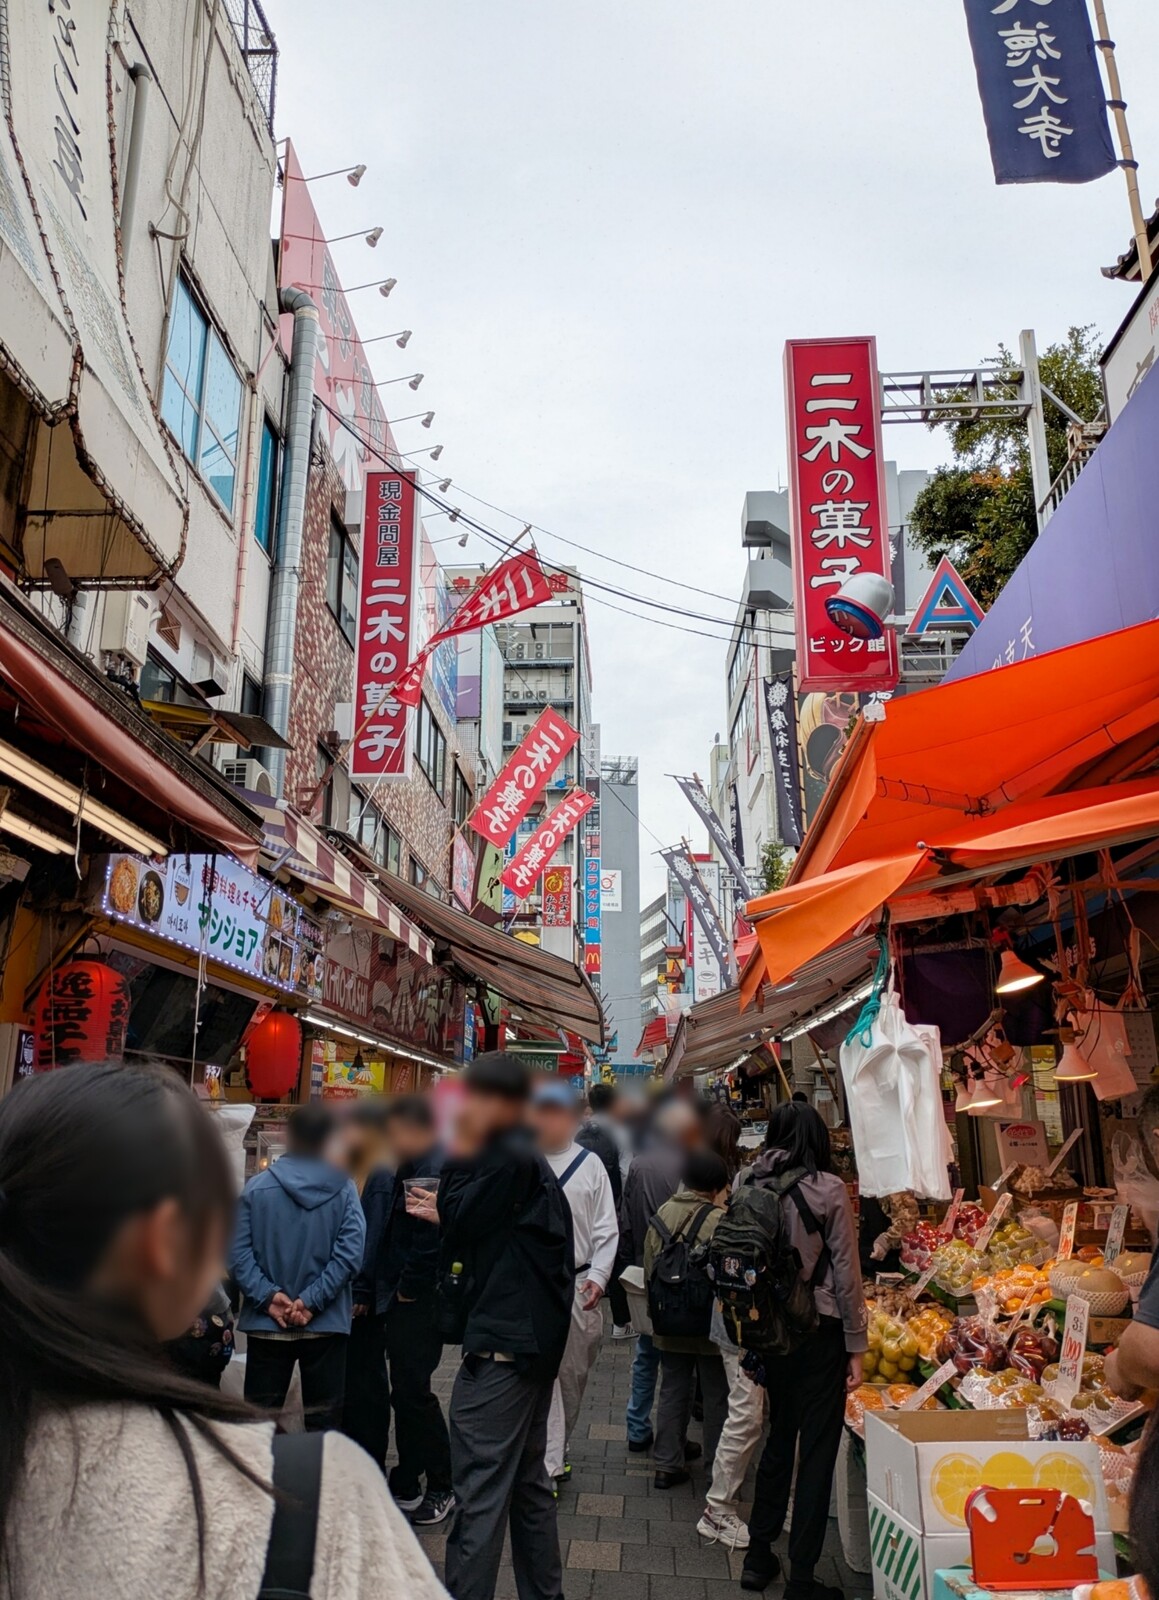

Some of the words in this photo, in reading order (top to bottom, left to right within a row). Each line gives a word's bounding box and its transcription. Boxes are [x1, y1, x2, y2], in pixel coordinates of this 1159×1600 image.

[801, 372, 874, 590] 二木の菓子
[376, 479, 402, 567] 現金問屋
[359, 577, 406, 763] 二木の菓子
[810, 635, 886, 653] ビック館
[587, 861, 598, 927] カラオケ館
[198, 902, 259, 961] マシジョア
[698, 987, 717, 997] 地下
